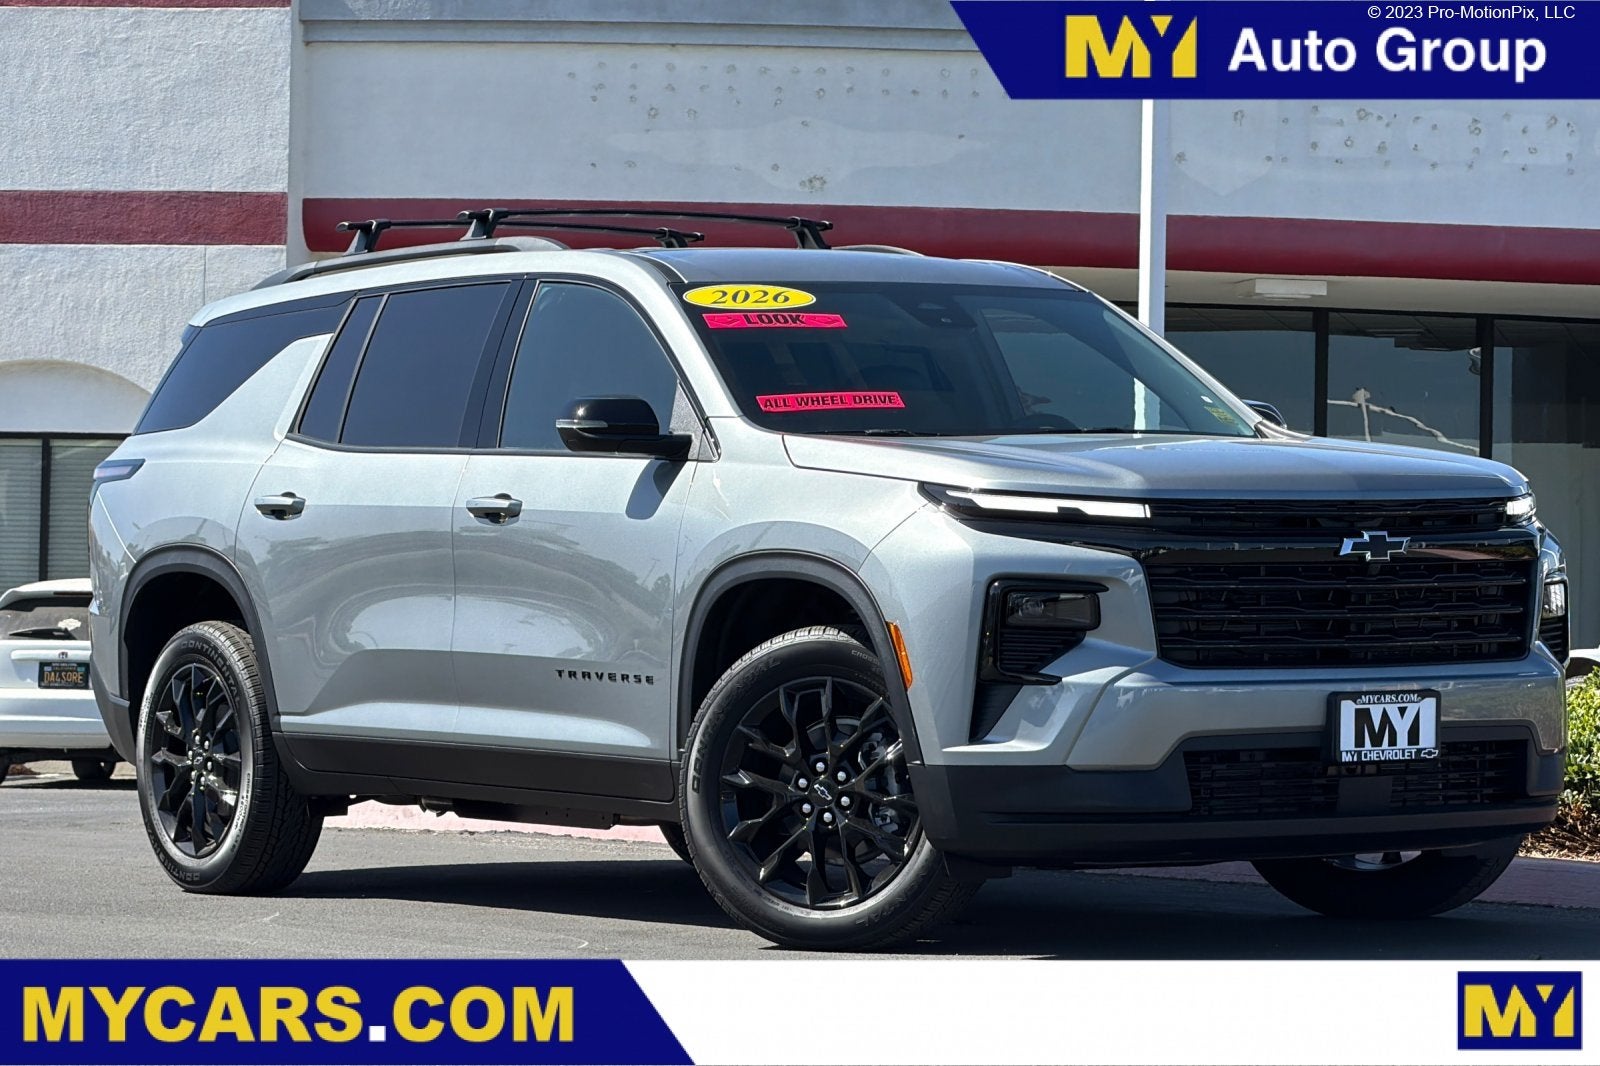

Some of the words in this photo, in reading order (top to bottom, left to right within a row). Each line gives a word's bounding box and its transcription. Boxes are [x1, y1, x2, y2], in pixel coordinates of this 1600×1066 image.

[711, 289, 791, 305] 2026
[742, 313, 806, 326] LOOK
[763, 397, 792, 409] ALL
[796, 395, 849, 407] WHEEL
[852, 394, 897, 405] DRIVE
[555, 669, 654, 685] TRAVERSE
[1361, 693, 1418, 704] MYCARS.COM
[1354, 705, 1420, 749] MY
[1341, 751, 1358, 762] MY
[1361, 748, 1417, 761] CHEVROLET
